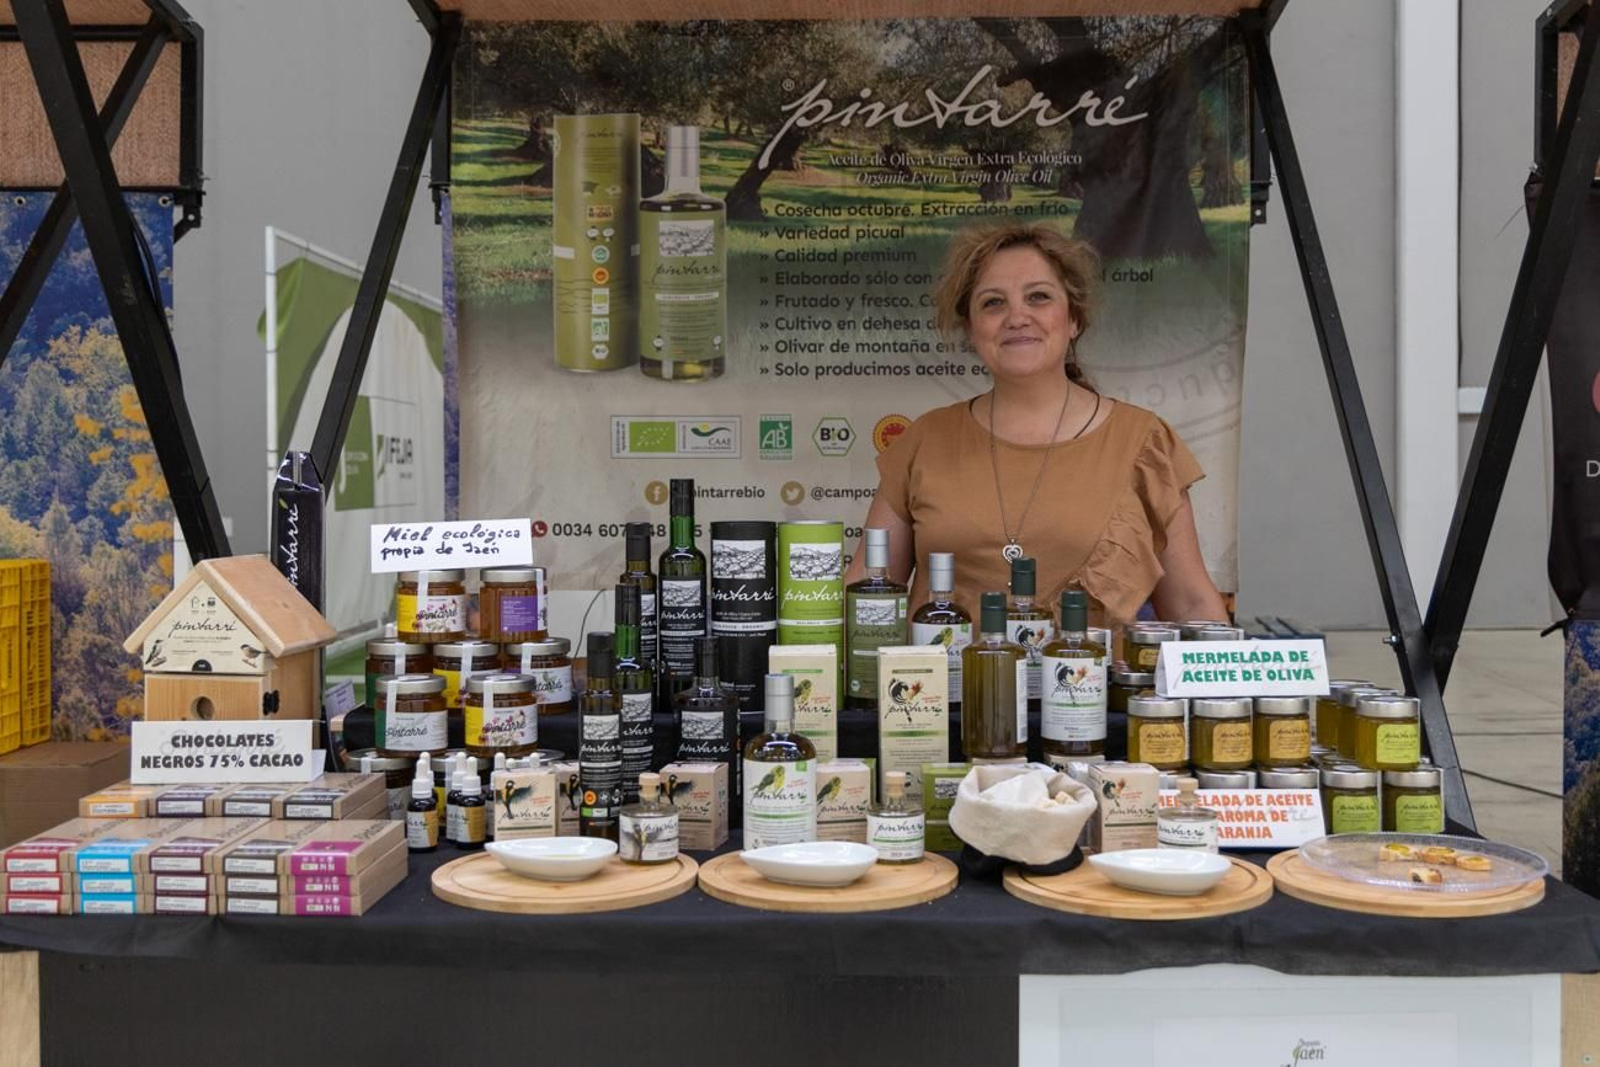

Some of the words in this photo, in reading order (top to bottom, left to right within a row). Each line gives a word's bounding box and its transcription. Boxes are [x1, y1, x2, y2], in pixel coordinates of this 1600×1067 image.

[759, 65, 1148, 170] pintarré
[827, 153, 867, 167] Aceite
[870, 152, 887, 166] de
[890, 152, 925, 168] Oliva
[927, 152, 973, 168] Virgen
[978, 152, 1014, 166] Extra
[1018, 150, 1083, 168] Ecológico
[856, 170, 909, 187] Organic
[911, 171, 948, 184] Extra
[950, 170, 991, 186] Virgin
[994, 169, 1029, 184] Olive
[1031, 169, 1053, 184] Oil
[774, 202, 842, 217] Cosecha
[847, 202, 915, 217] octubre.
[921, 201, 1009, 218] Extracción
[1014, 205, 1034, 216] en
[1039, 201, 1069, 216] frío
[774, 225, 850, 240] Variedad
[856, 224, 905, 242] picual
[774, 247, 838, 263] Calidad
[843, 249, 917, 266] premium
[774, 270, 860, 286] Elaborado
[865, 271, 899, 286] sólo
[903, 273, 933, 285] con
[1111, 266, 1154, 283] árbol
[774, 294, 841, 308] Frutado
[845, 297, 855, 311] y
[861, 293, 914, 308] fresco.
[774, 316, 832, 331] Cultivo
[837, 319, 857, 331] en
[862, 317, 920, 331] dehesa
[774, 338, 825, 353] Olivar
[830, 338, 850, 353] de
[855, 339, 931, 353] montaña
[774, 361, 810, 377] Solo
[815, 361, 911, 380] producimos
[915, 360, 966, 377] aceite
[383, 526, 433, 544] Miel
[442, 523, 521, 544] ecológica
[552, 522, 593, 538] 0034
[598, 523, 627, 538] 607
[278, 497, 301, 588] intarré
[380, 545, 426, 561] propia
[435, 541, 453, 555] de
[462, 542, 500, 555] Jaén
[1181, 650, 1285, 664] MERMELADA
[1288, 650, 1310, 663] DE
[1181, 669, 1238, 683] ACEITE
[1241, 669, 1263, 682] DE
[1266, 667, 1315, 682] OLIVA
[171, 733, 275, 749] CHOCOLATES
[140, 754, 204, 770] NEGROS
[209, 753, 245, 769] 75%
[249, 752, 304, 768] CACAO
[1245, 794, 1262, 807] DE
[1266, 794, 1313, 807] ACEITE
[1216, 810, 1265, 823] AROMA
[1270, 809, 1289, 822] DE
[1216, 826, 1273, 839] ARANJA
